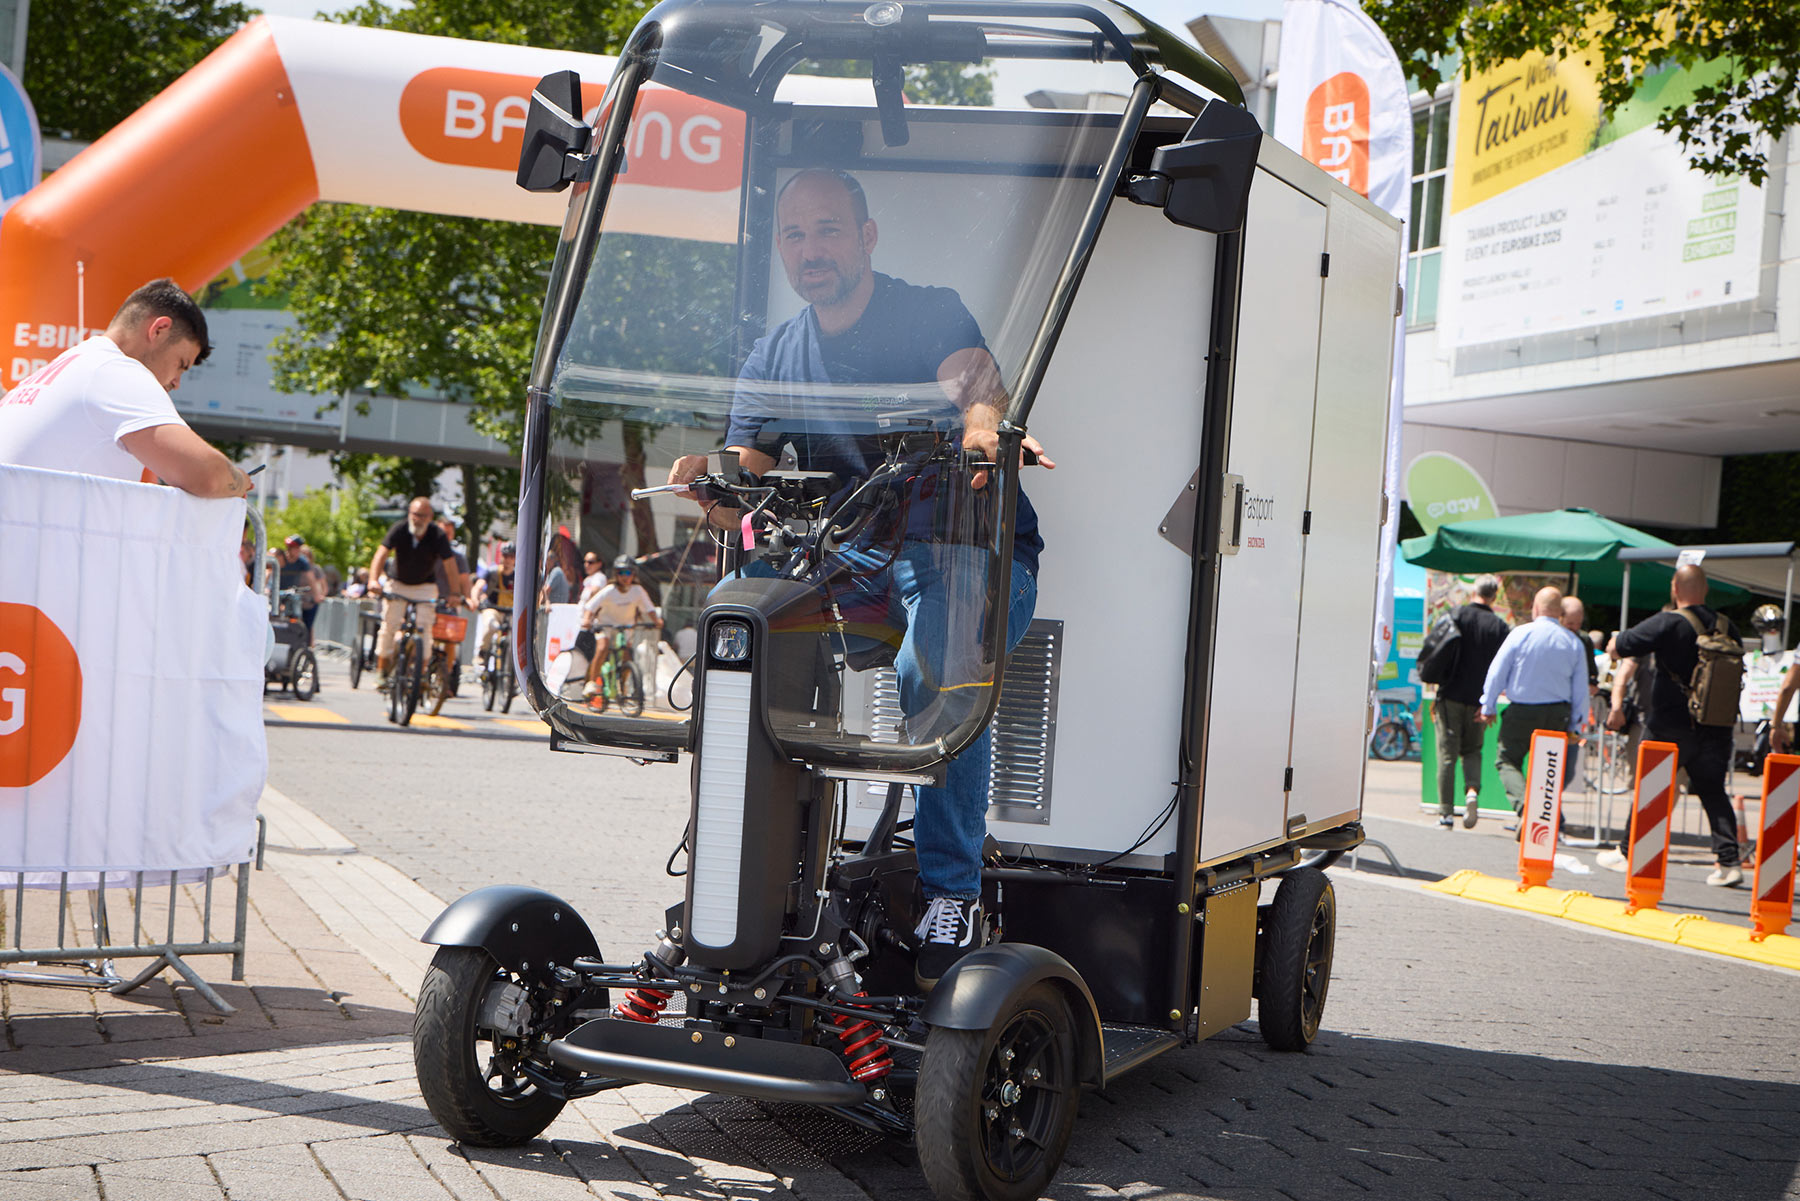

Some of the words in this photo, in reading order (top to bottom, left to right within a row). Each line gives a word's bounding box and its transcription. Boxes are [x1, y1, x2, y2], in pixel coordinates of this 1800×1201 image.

[444, 89, 722, 164] BANG
[1475, 76, 1569, 156] Taiwan
[1501, 232, 1541, 254] EUROBIKE
[1539, 750, 1559, 823] horizont
